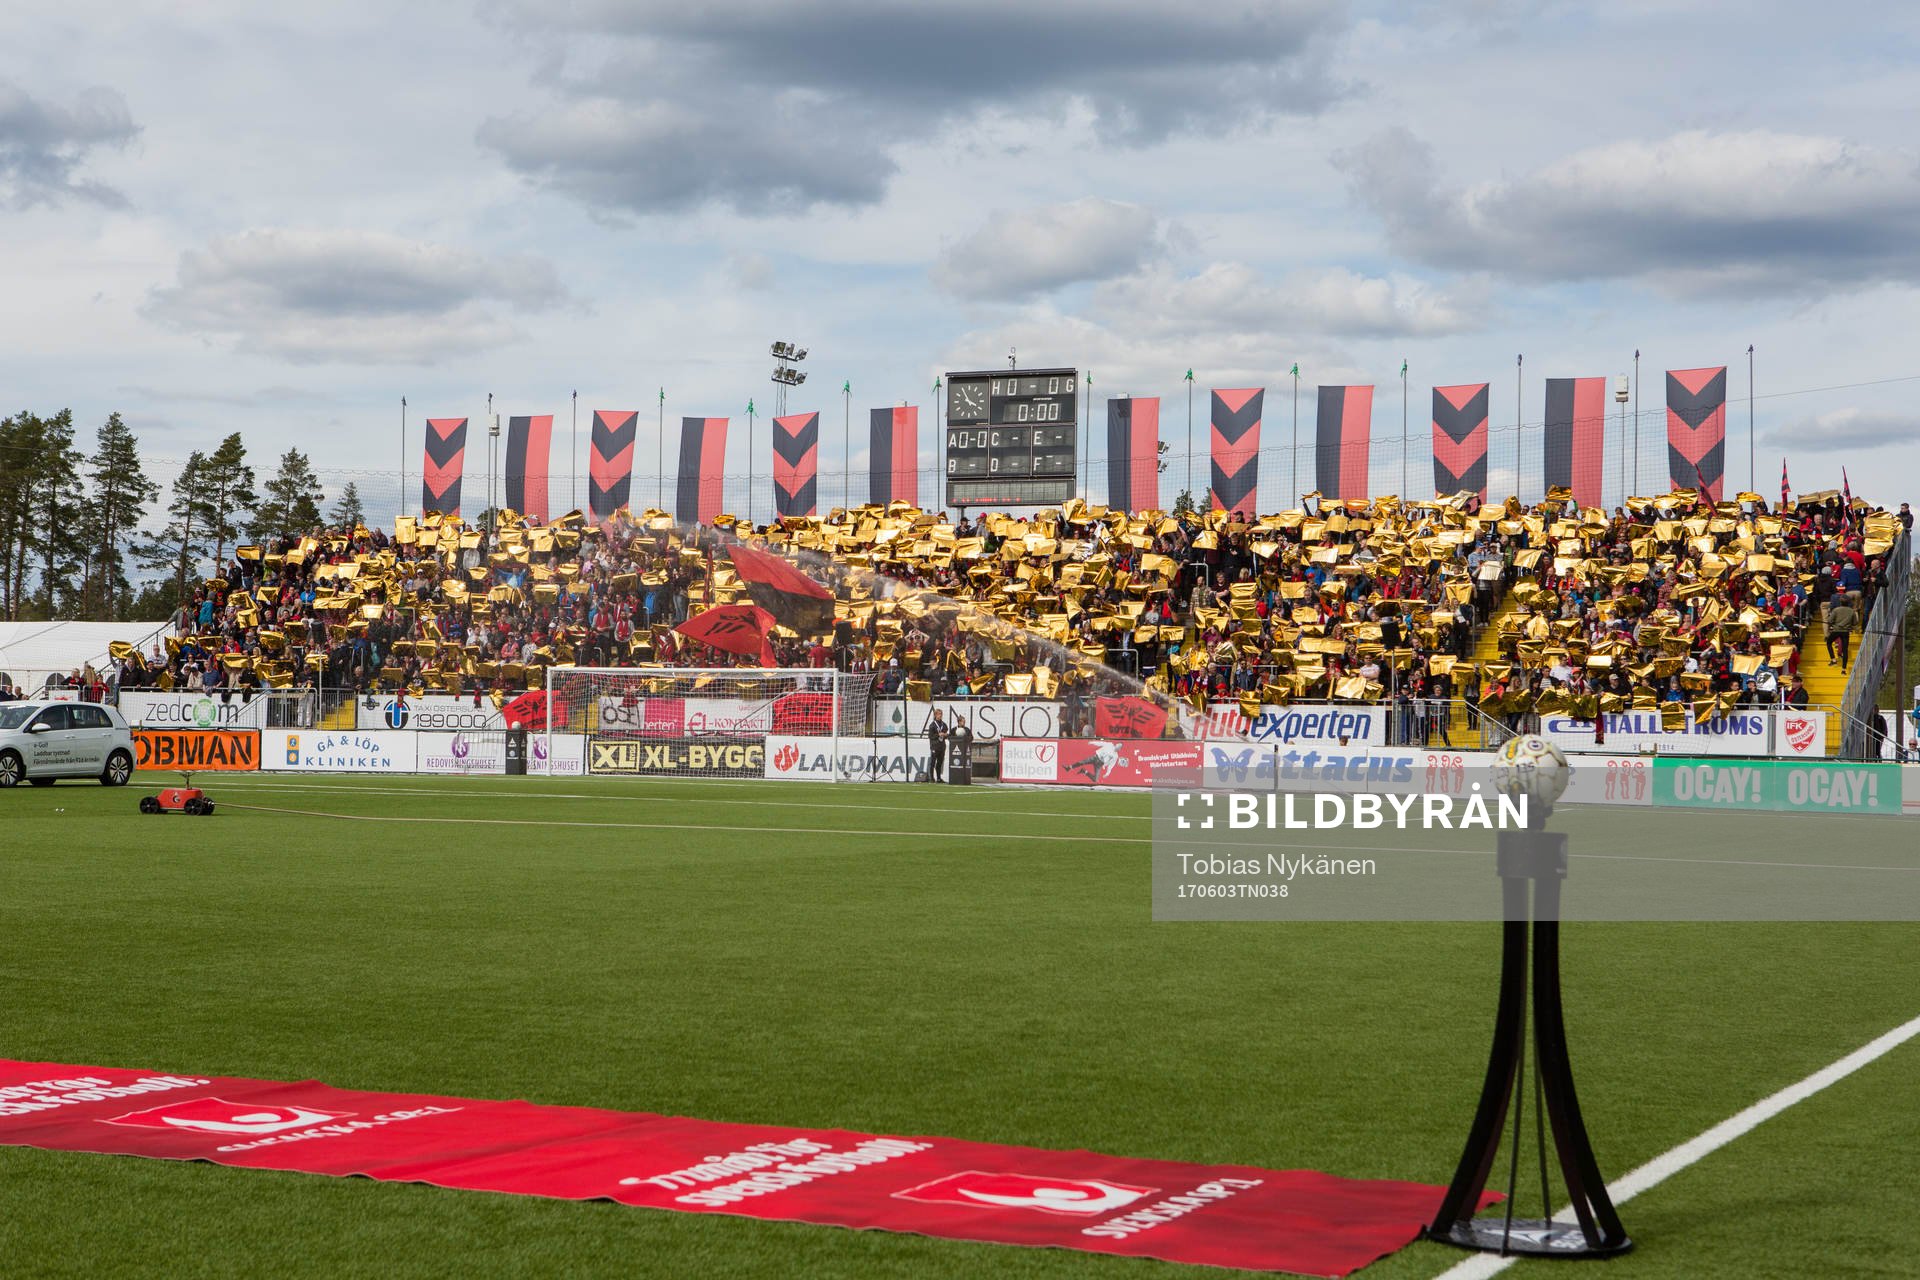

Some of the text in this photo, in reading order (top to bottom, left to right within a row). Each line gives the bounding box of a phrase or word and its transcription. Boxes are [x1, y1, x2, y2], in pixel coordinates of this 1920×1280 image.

[1018, 403, 1059, 422] 0:00
[414, 704, 432, 712] TAXI
[1786, 722, 1802, 730] IFK
[134, 735, 252, 765] OBMAN
[317, 735, 335, 752] GÅ
[355, 737, 380, 753] LÖP
[306, 756, 391, 768] KLINIKEN
[593, 745, 635, 768] XL
[643, 744, 764, 769] XL-BYGG
[1674, 765, 1762, 804] OCAY!
[1788, 768, 1878, 808] OCAY!
